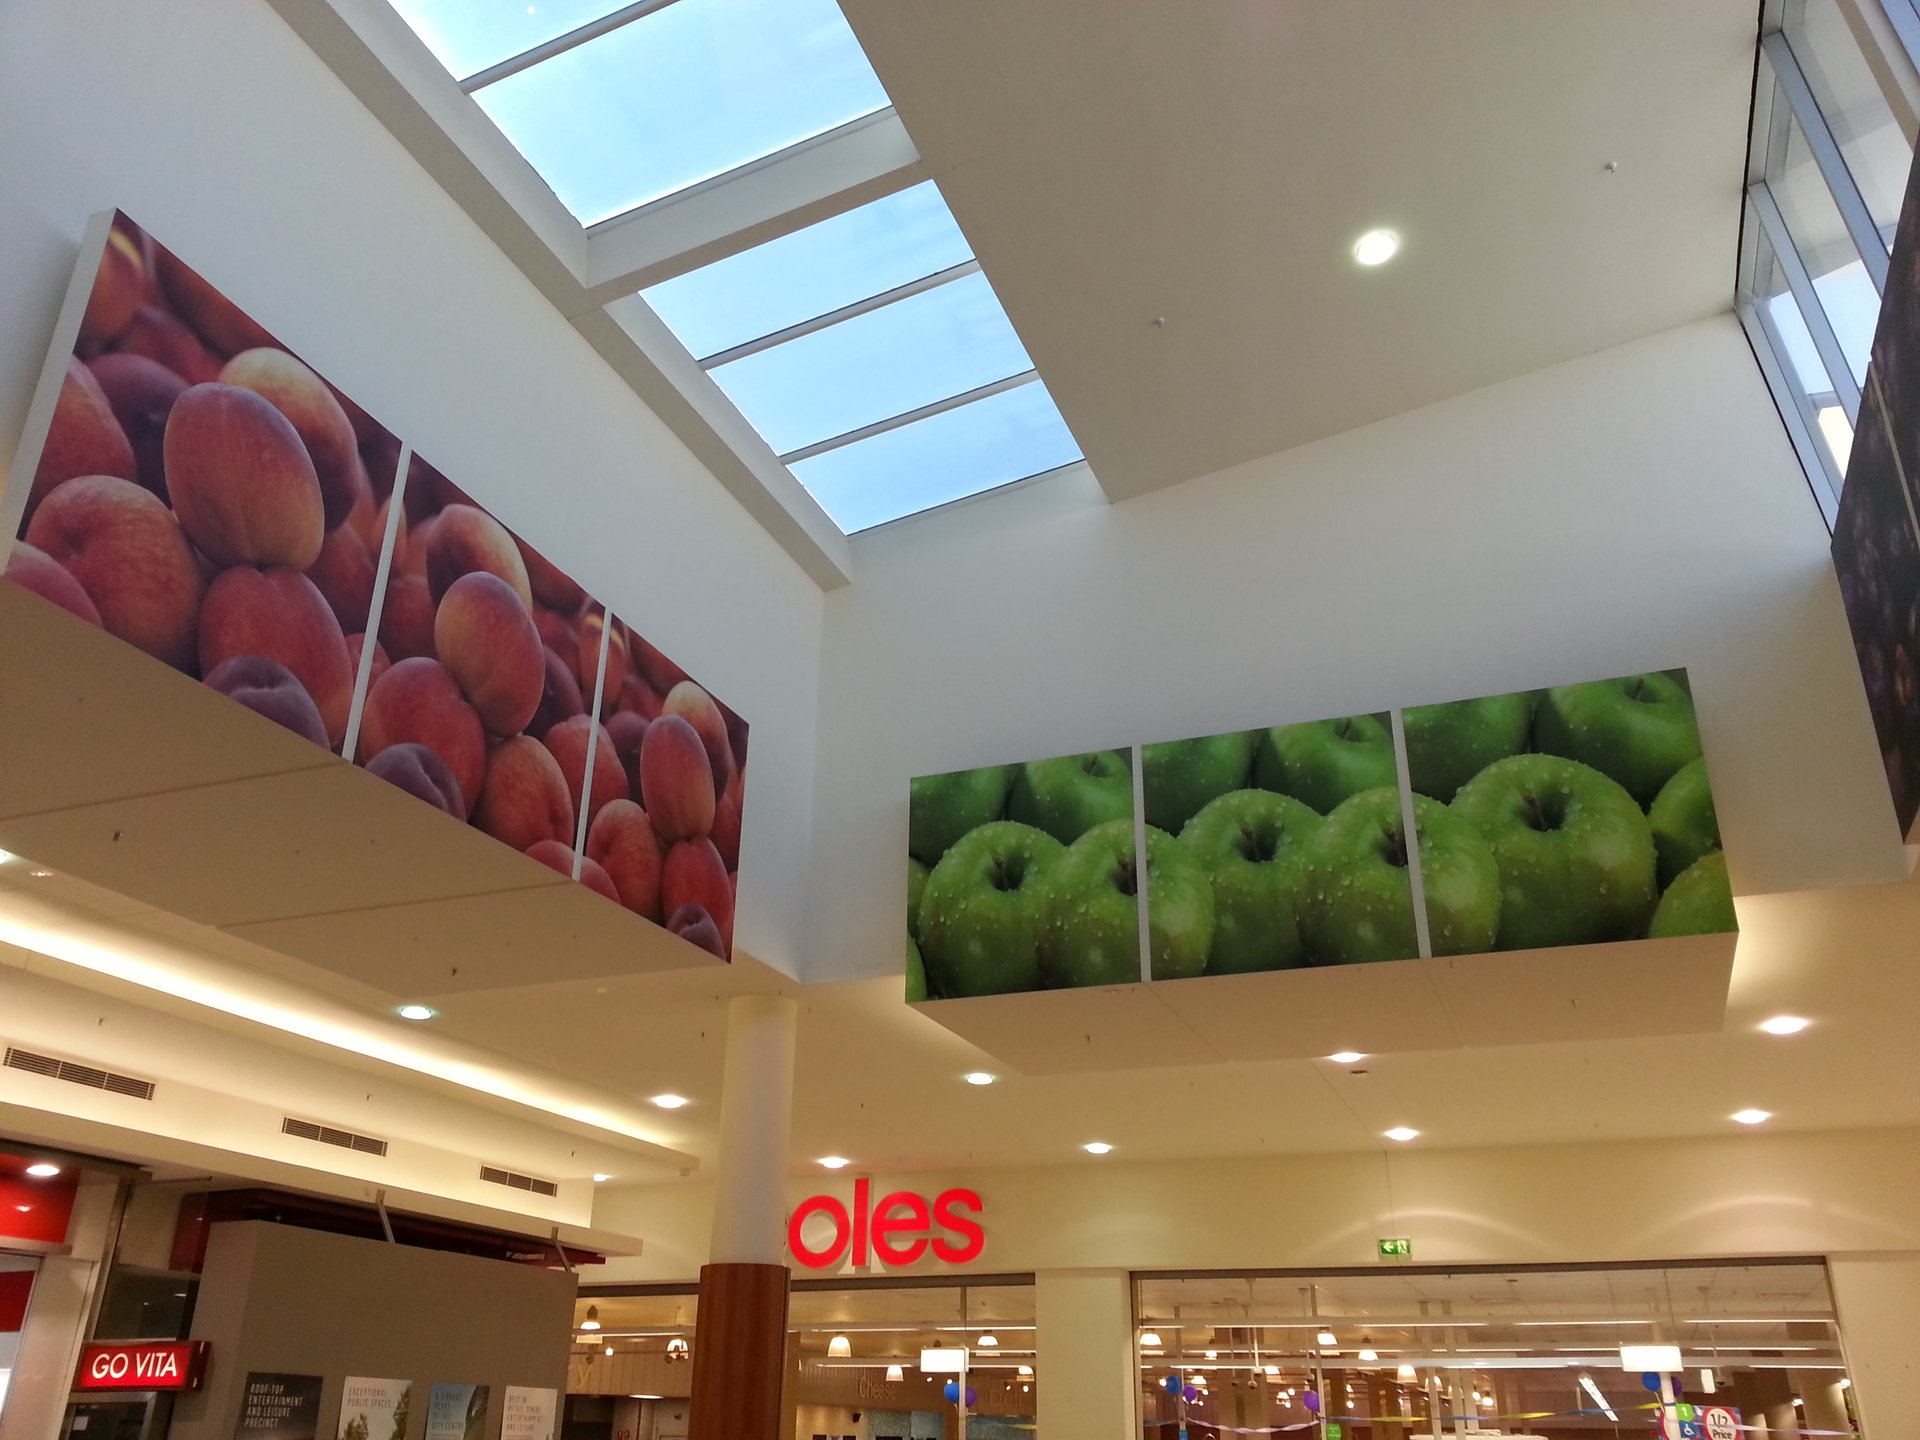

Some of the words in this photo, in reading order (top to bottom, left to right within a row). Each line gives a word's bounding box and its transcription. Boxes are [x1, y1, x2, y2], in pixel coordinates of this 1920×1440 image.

[784, 1177, 985, 1269] oles
[92, 1353, 129, 1379] GO
[136, 1352, 177, 1378] VITA
[250, 1383, 284, 1394] ROOF-TOP
[858, 1376, 895, 1400] Cheese
[248, 1394, 303, 1406] ENTERTAINMENT
[246, 1406, 262, 1416] AND
[263, 1407, 291, 1417] LEISURE
[1682, 1407, 1687, 1416] 1
[244, 1417, 278, 1428] PRECINCT
[1711, 1413, 1728, 1428] 1/2
[1712, 1429, 1733, 1440] Price
